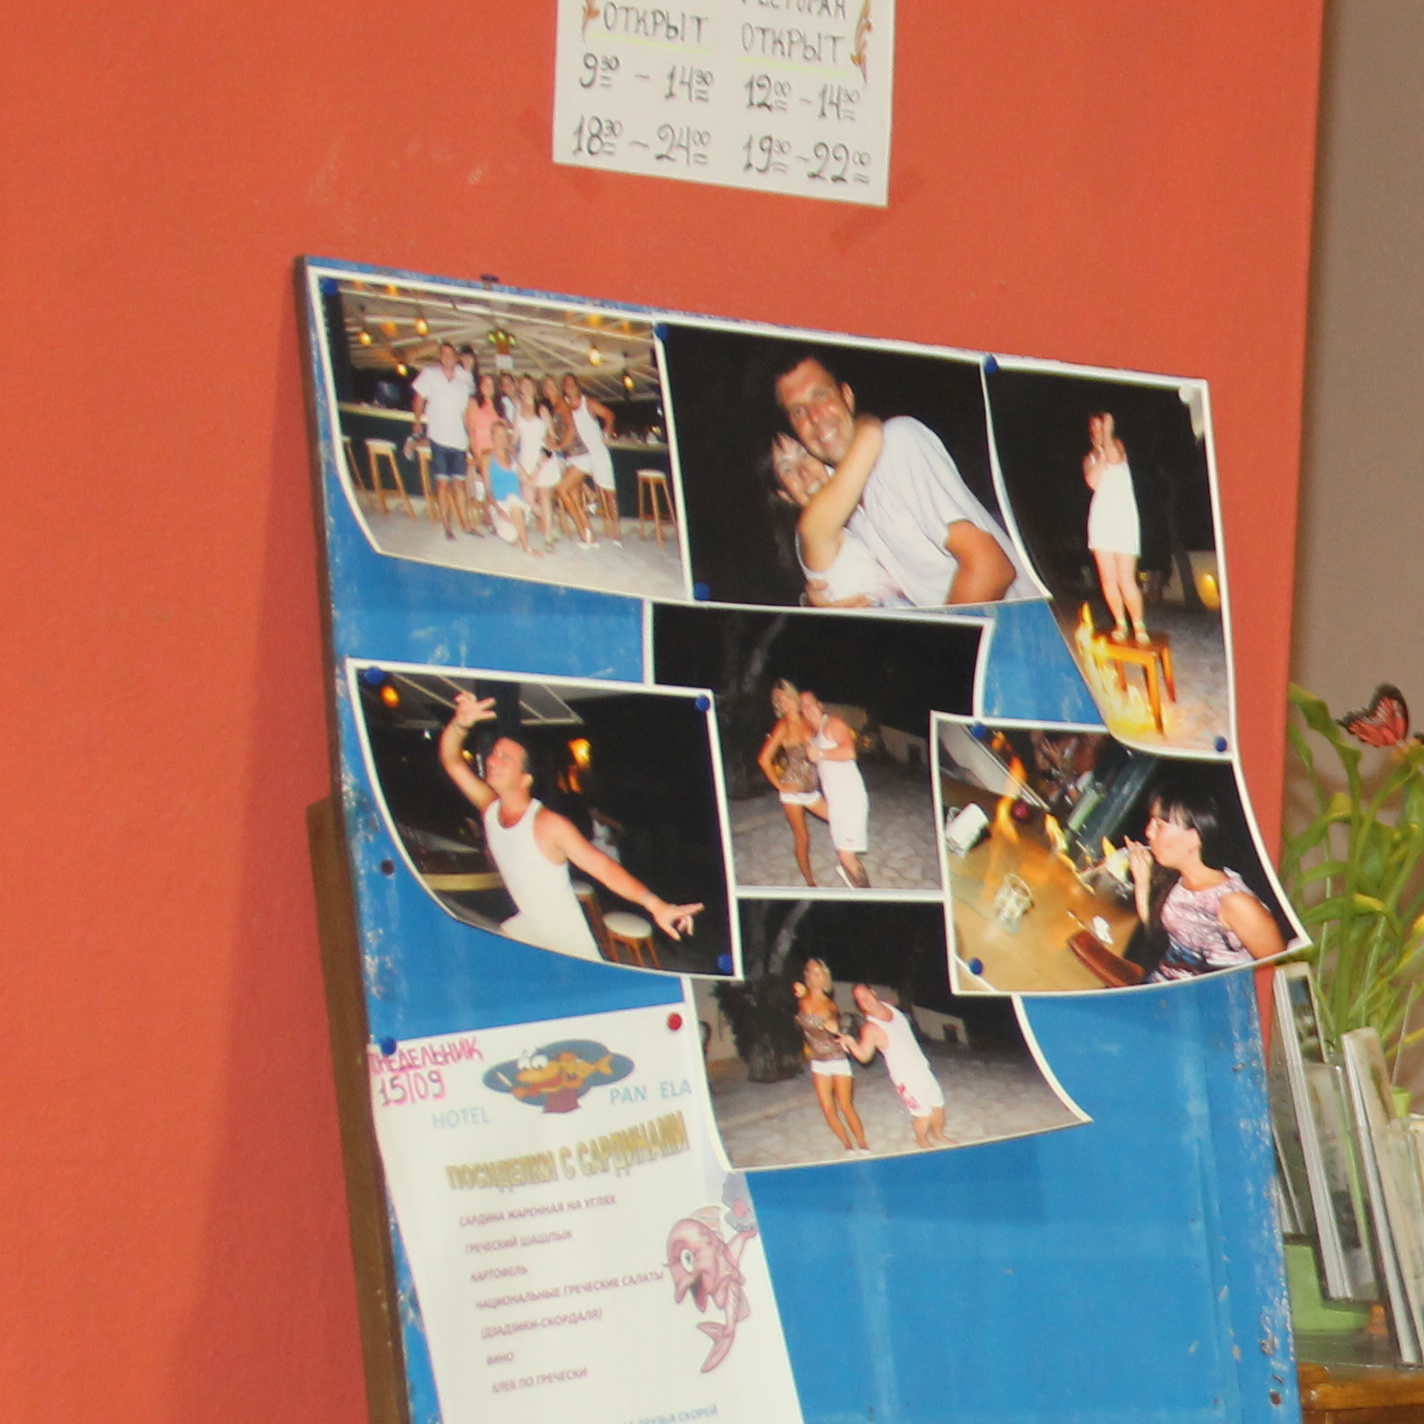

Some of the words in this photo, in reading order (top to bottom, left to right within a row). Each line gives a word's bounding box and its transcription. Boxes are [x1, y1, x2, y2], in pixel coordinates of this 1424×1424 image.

[603, 1, 709, 43] ОТКРЫТ
[741, 21, 845, 63] ОТКРЫТ
[379, 1068, 447, 1108] 15/09
[432, 1106, 490, 1130] HOTEL
[609, 1085, 647, 1106] PAN
[659, 1079, 693, 1100] ELA
[576, 1109, 690, 1177] САРДИНАМИ
[621, 1271, 665, 1287] САЛАТЫ
